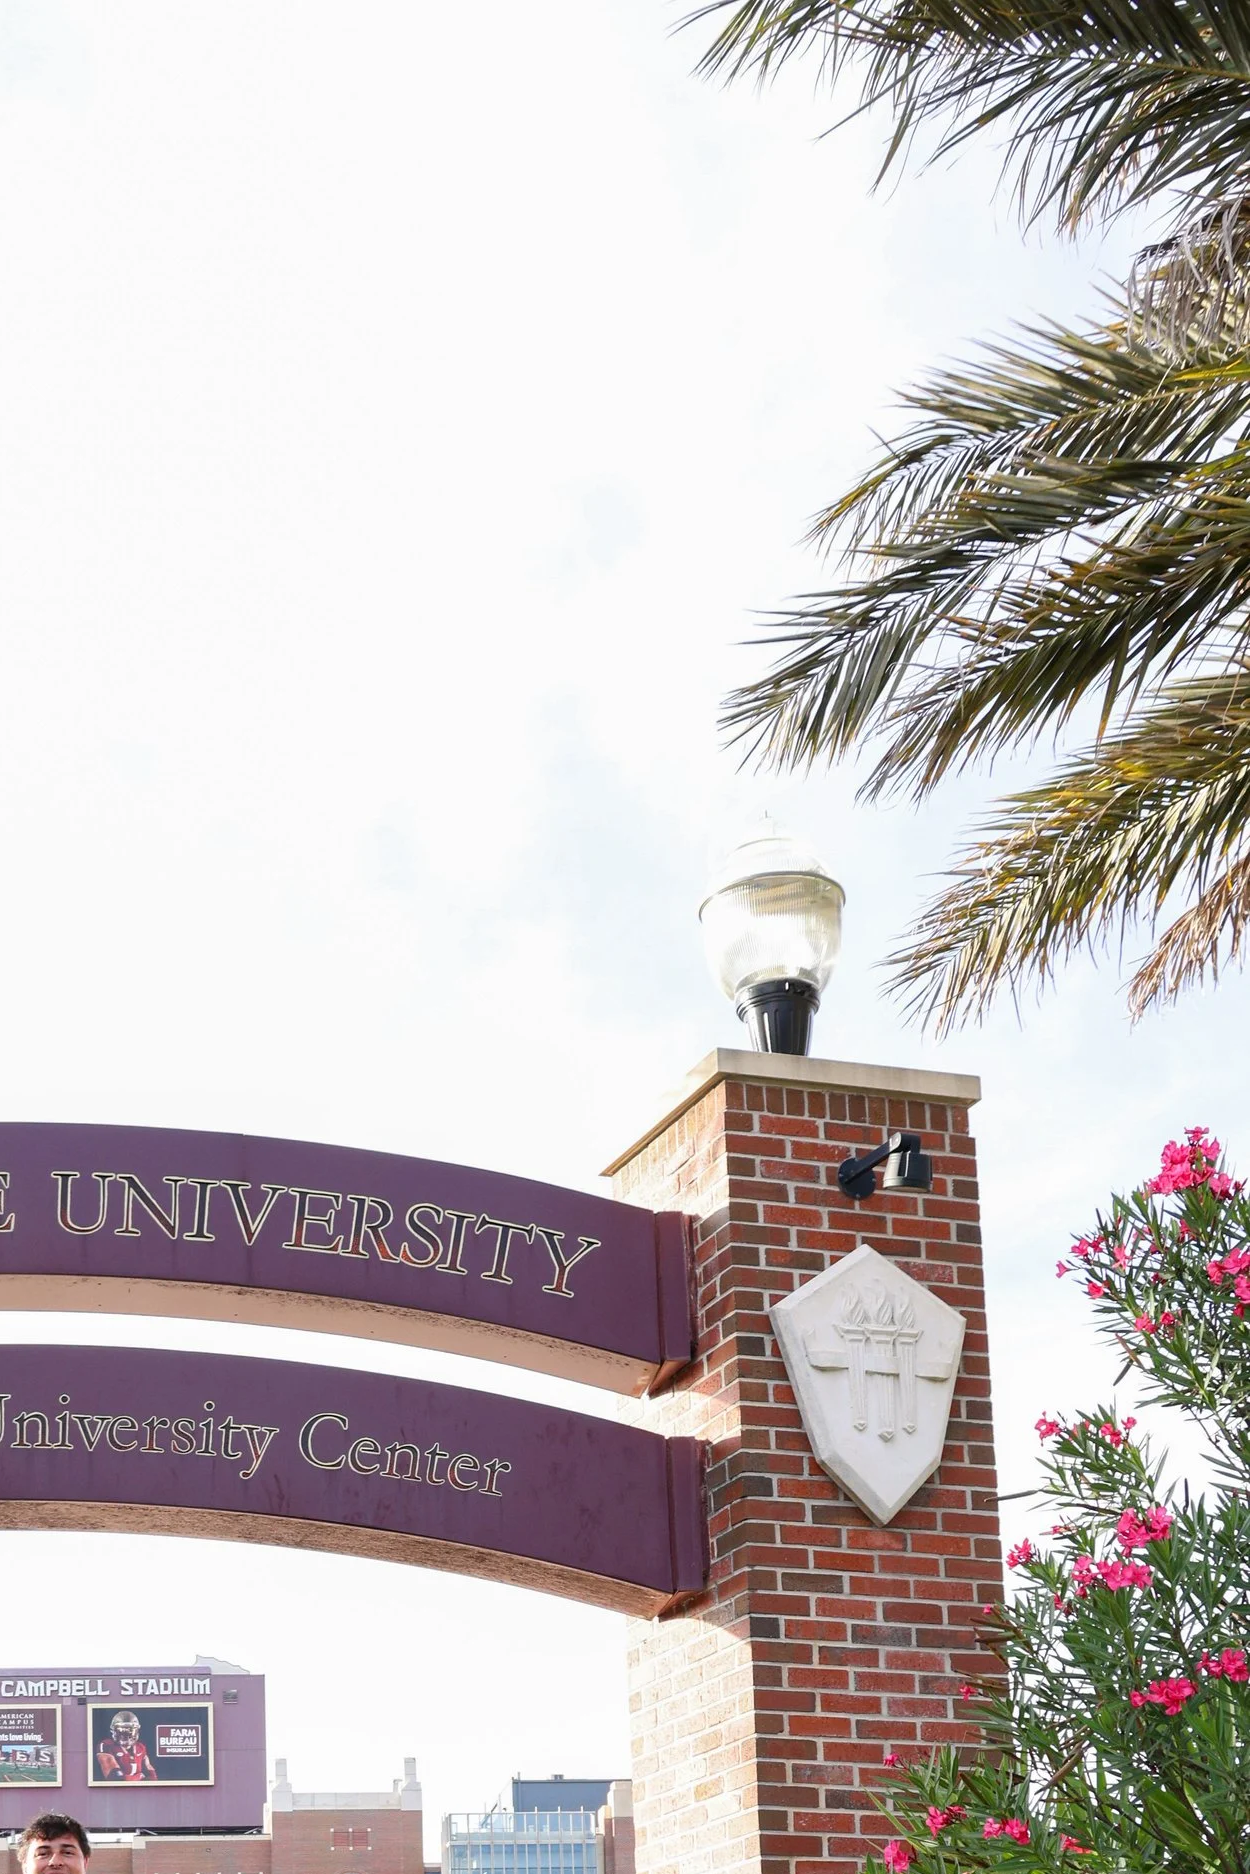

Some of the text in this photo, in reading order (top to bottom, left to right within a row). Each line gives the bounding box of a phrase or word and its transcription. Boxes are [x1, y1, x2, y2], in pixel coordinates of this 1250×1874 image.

[51, 1170, 601, 1298] UNIVERSITY
[298, 1412, 512, 1496] Center
[0, 1680, 110, 1697] CAMPBELL
[120, 1678, 211, 1695] STADIUM
[9, 1733, 23, 1741] love
[170, 1728, 197, 1737] FARM
[159, 1737, 197, 1746] BUREAU
